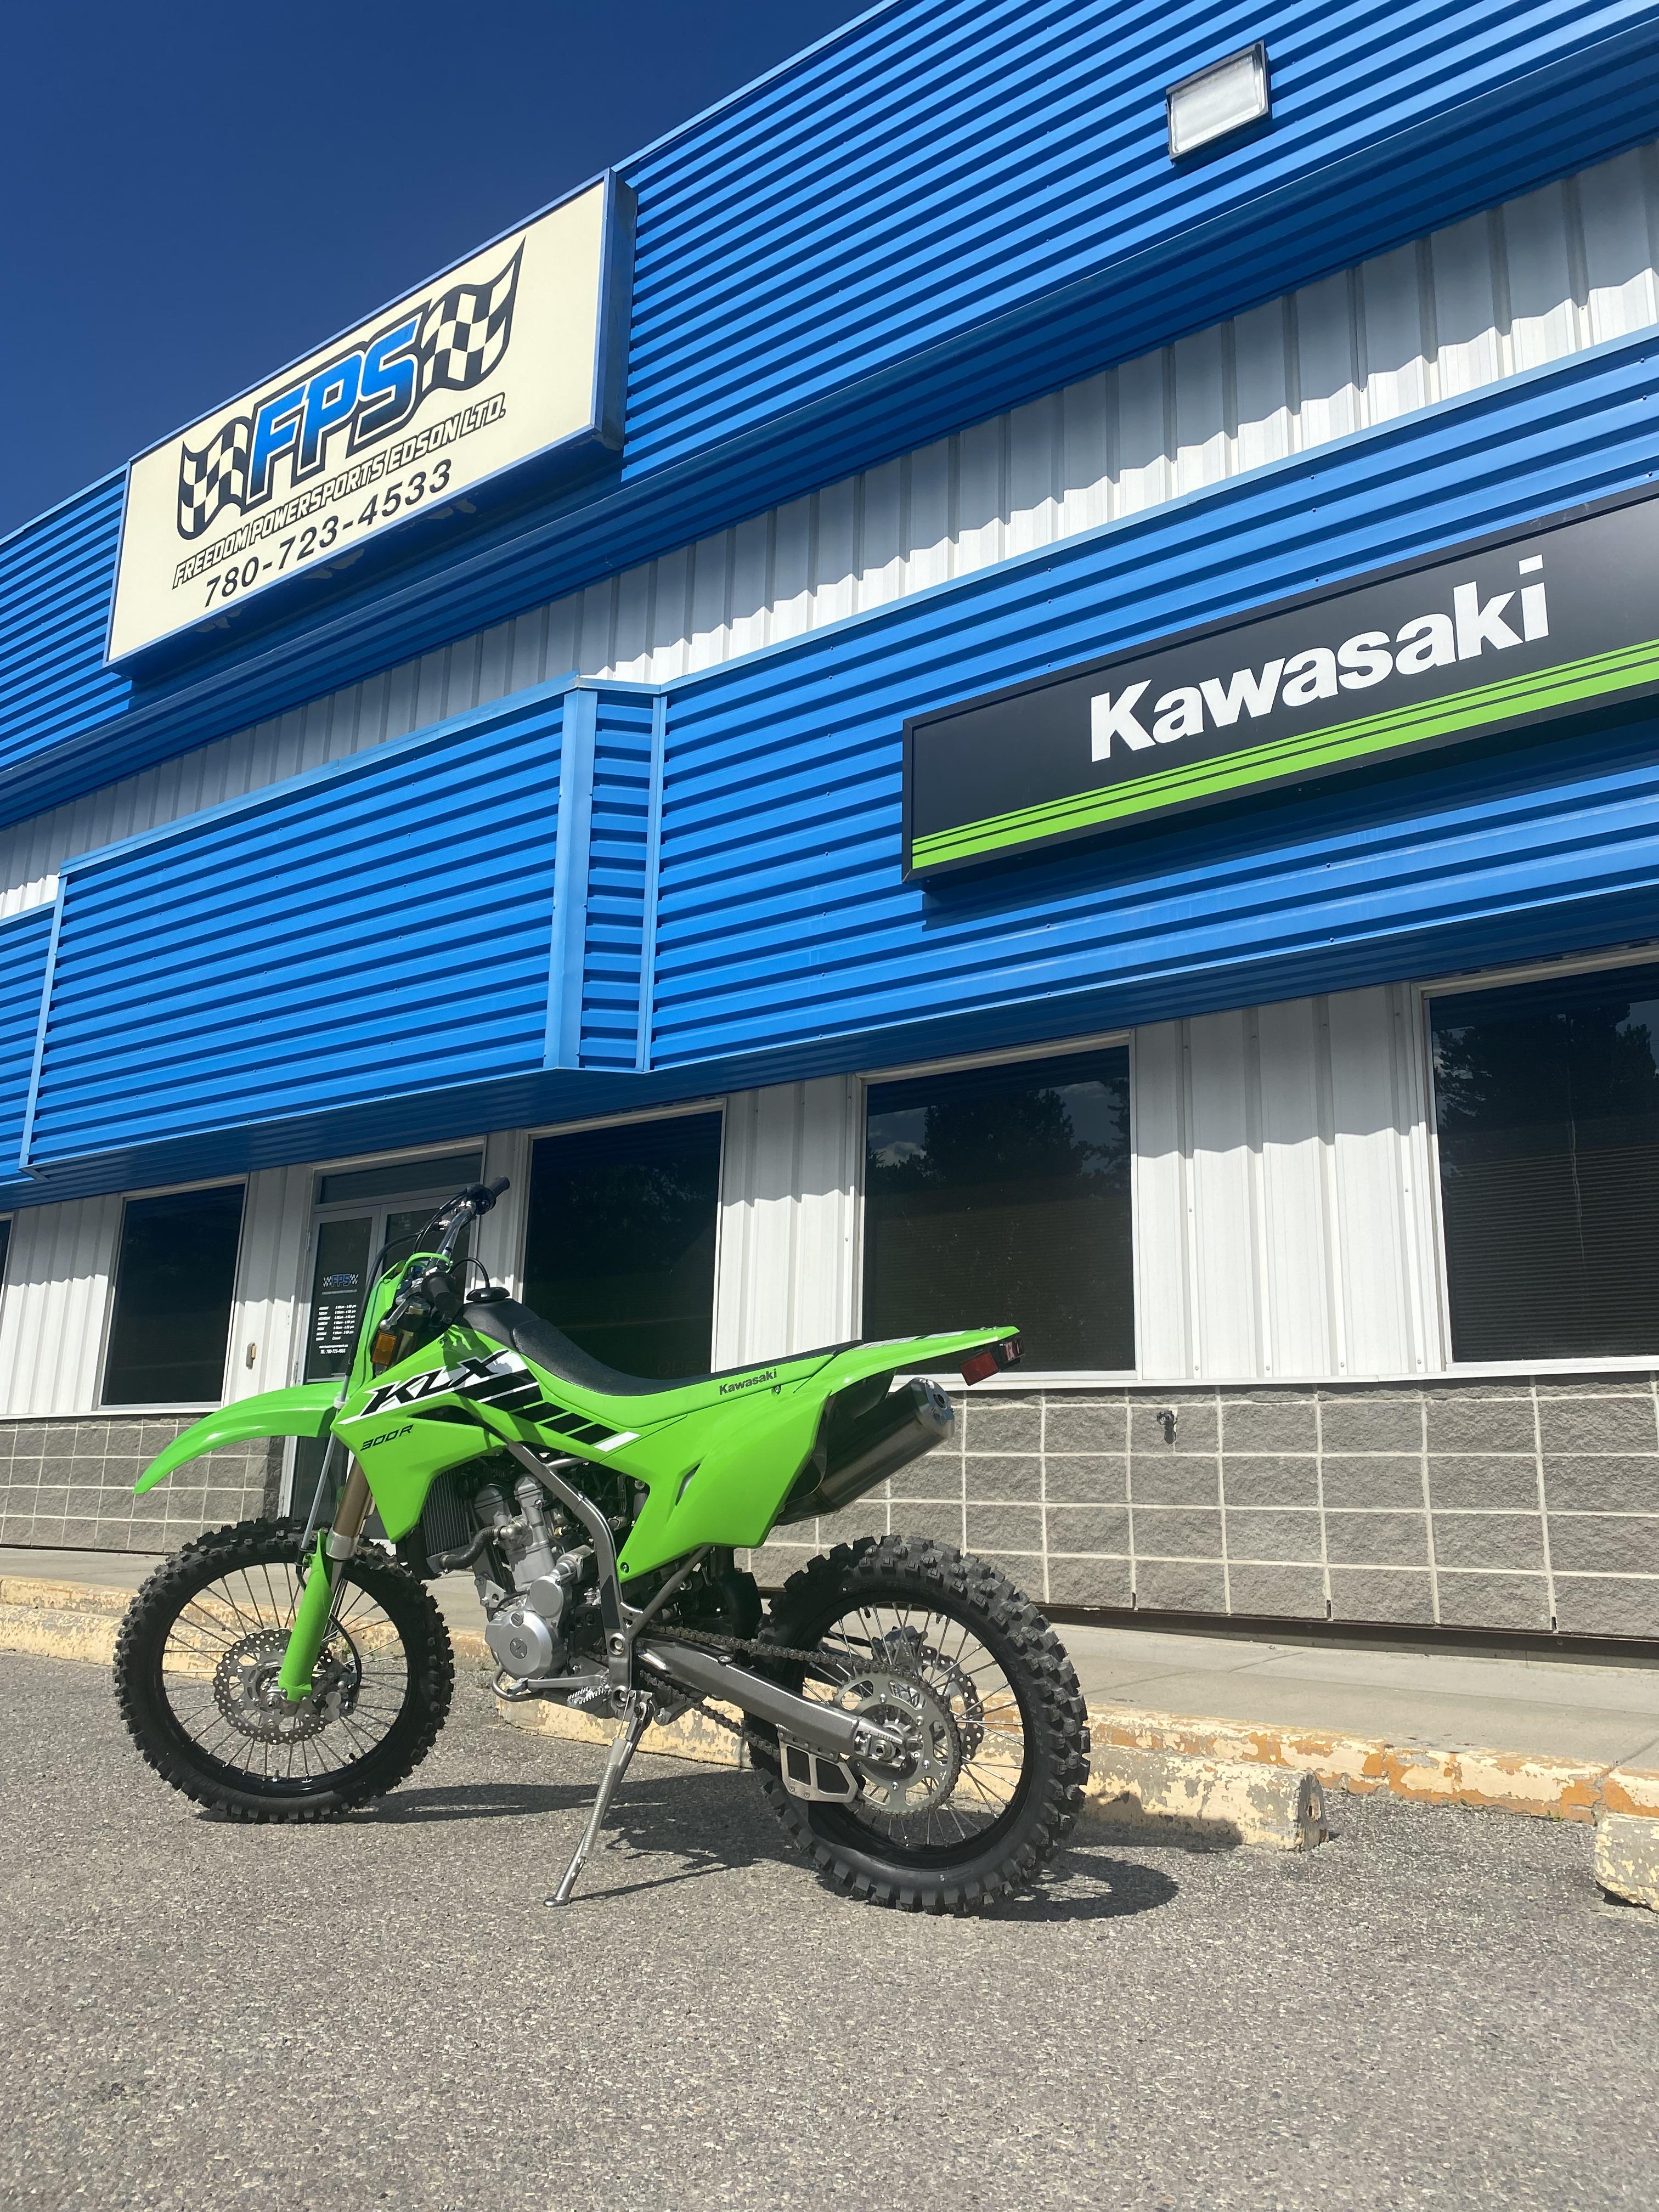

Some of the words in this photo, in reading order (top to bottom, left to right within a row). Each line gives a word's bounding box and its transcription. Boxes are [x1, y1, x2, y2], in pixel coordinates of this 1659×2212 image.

[245, 312, 424, 507] FPS
[172, 523, 251, 590] FREEDOM
[248, 449, 388, 546] POWERSPORTS
[386, 411, 462, 475] EDSON
[459, 392, 506, 438] LTD.
[205, 459, 452, 607] 780-723-4533
[1090, 554, 1549, 762] Kawasaki
[331, 1273, 351, 1288] FPS
[360, 1350, 509, 1417] KLX
[719, 1369, 777, 1395] Kawasaki
